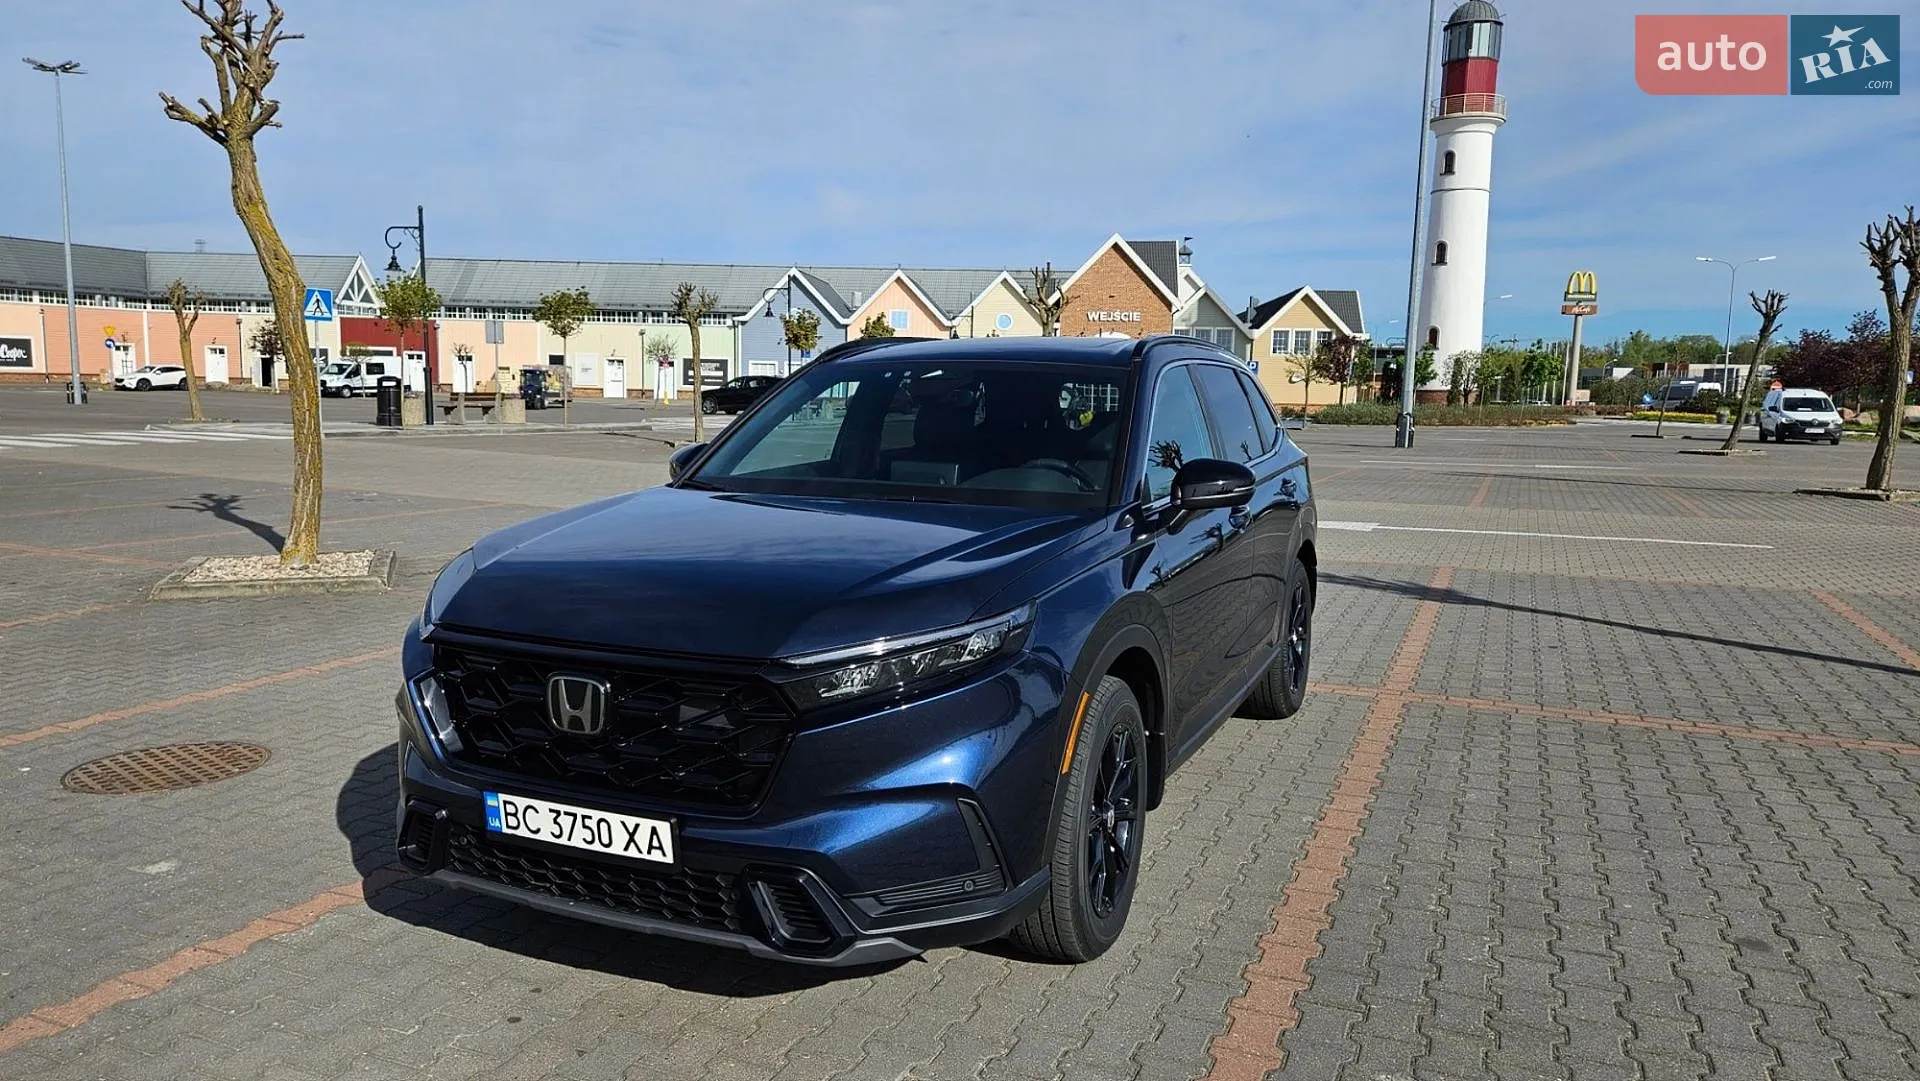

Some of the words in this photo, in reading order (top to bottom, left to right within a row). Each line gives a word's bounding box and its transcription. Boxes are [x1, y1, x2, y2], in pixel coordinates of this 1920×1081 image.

[1087, 309, 1141, 321] WEJŚCIE
[490, 817, 501, 828] UA
[502, 800, 541, 835] BC
[548, 808, 613, 848] 3750
[620, 820, 667, 857] XA
